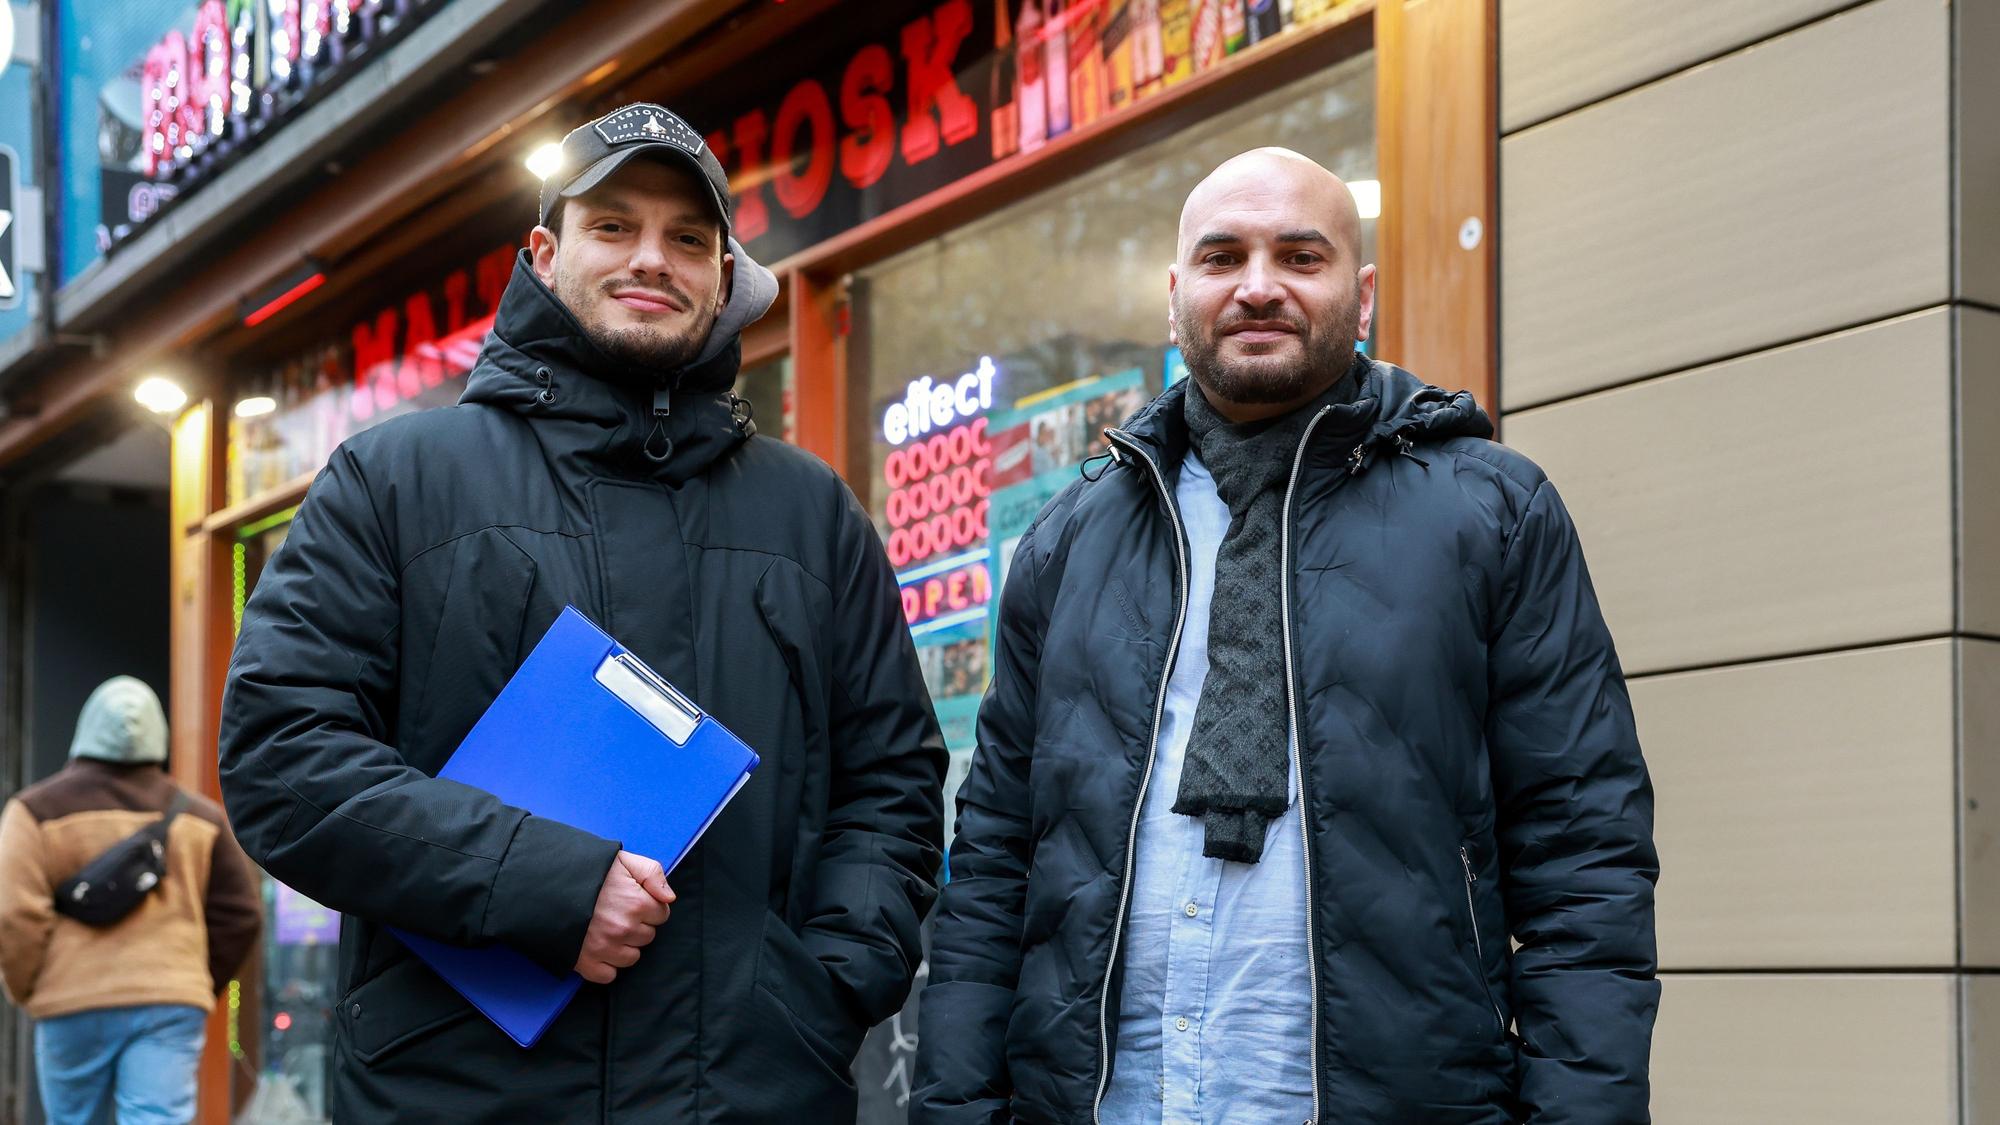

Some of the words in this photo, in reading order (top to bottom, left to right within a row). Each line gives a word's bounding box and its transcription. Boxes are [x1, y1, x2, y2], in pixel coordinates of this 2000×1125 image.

[608, 109, 694, 136] VISIONARY
[612, 131, 647, 142] SPACE
[651, 132, 695, 152] MISSION
[884, 355, 996, 444] effect
